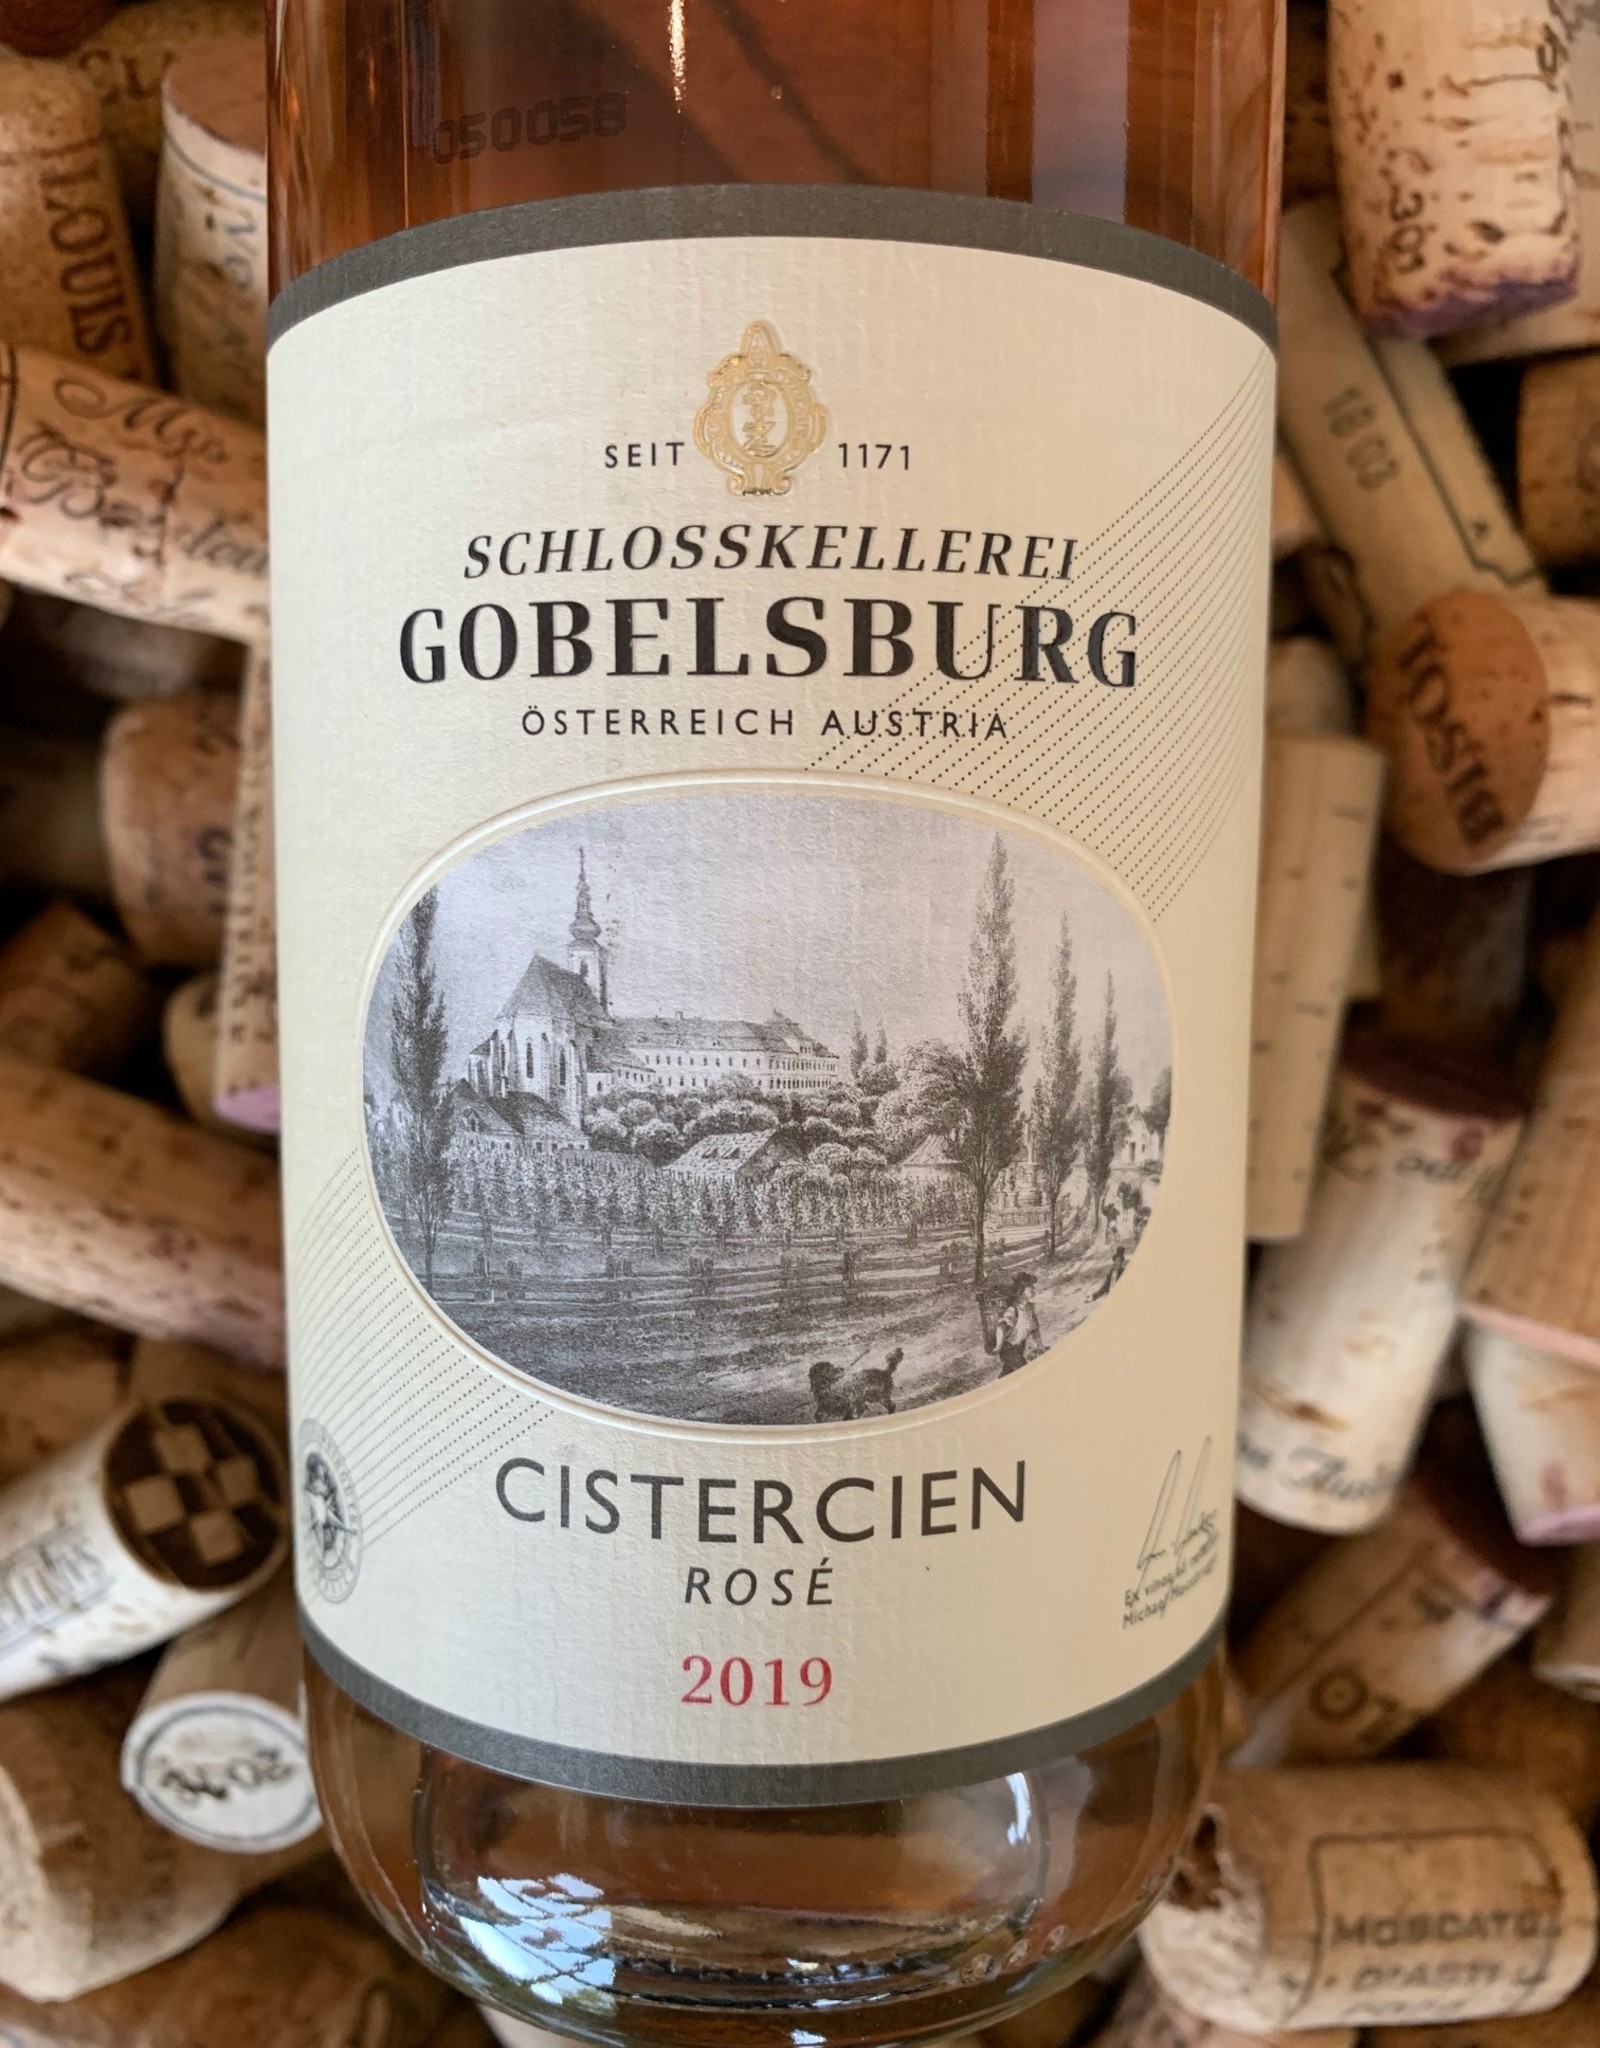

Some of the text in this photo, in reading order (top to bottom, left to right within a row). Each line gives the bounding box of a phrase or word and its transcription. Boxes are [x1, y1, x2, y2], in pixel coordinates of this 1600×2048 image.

[433, 91, 628, 165] 050058
[39, 158, 134, 355] LOUIS
[604, 441, 910, 471] SEIT 1171
[463, 523, 1079, 581] SCHLOSSKELLEREI
[399, 595, 1138, 688] GOBELSBURG
[521, 704, 1008, 739] ÖSTERREICH AUSTRIA
[495, 1457, 1027, 1545] CISTERCIEN
[683, 1557, 835, 1606] ROSÉ
[680, 1654, 834, 1707] 2019
